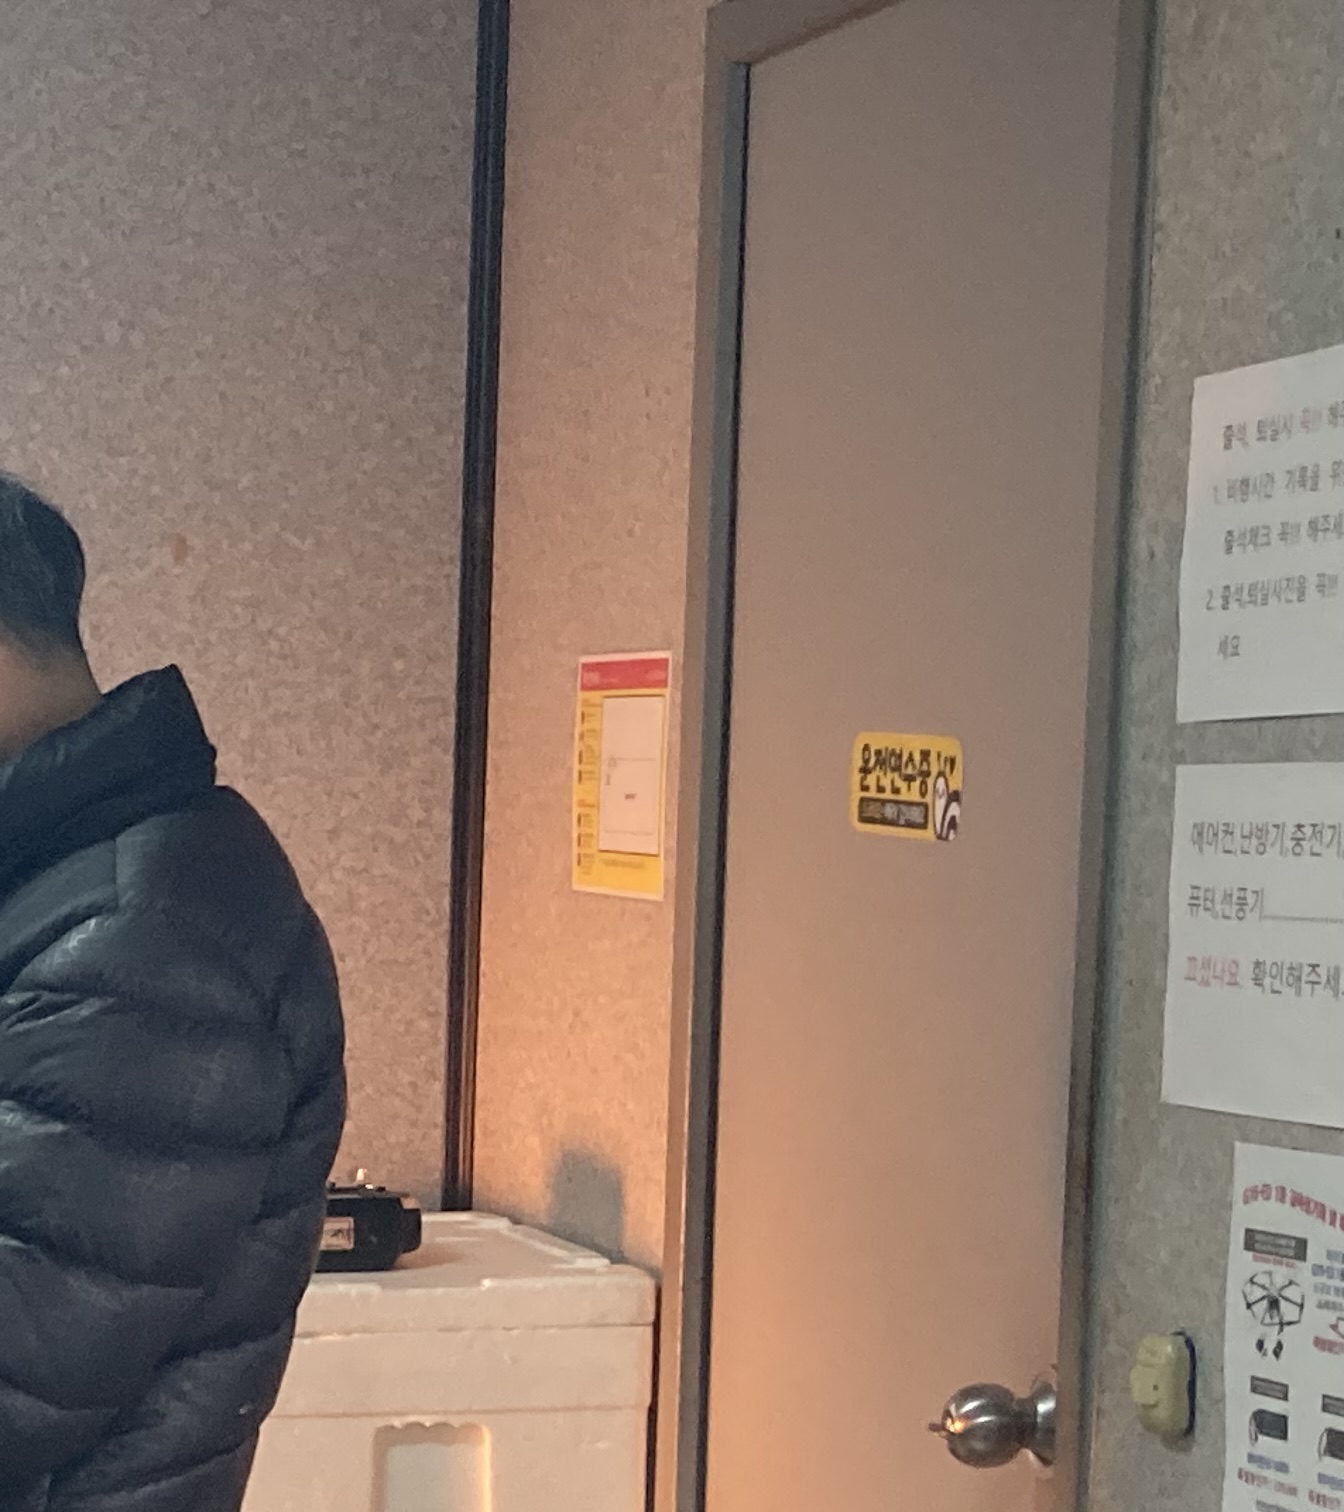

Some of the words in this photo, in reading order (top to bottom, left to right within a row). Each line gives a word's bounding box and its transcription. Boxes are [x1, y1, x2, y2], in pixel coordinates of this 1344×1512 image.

[1226, 472, 1276, 504] 비행시간
[1284, 463, 1321, 494] 기록을
[1223, 524, 1272, 555] 출석체크
[1217, 634, 1241, 661] 세요
